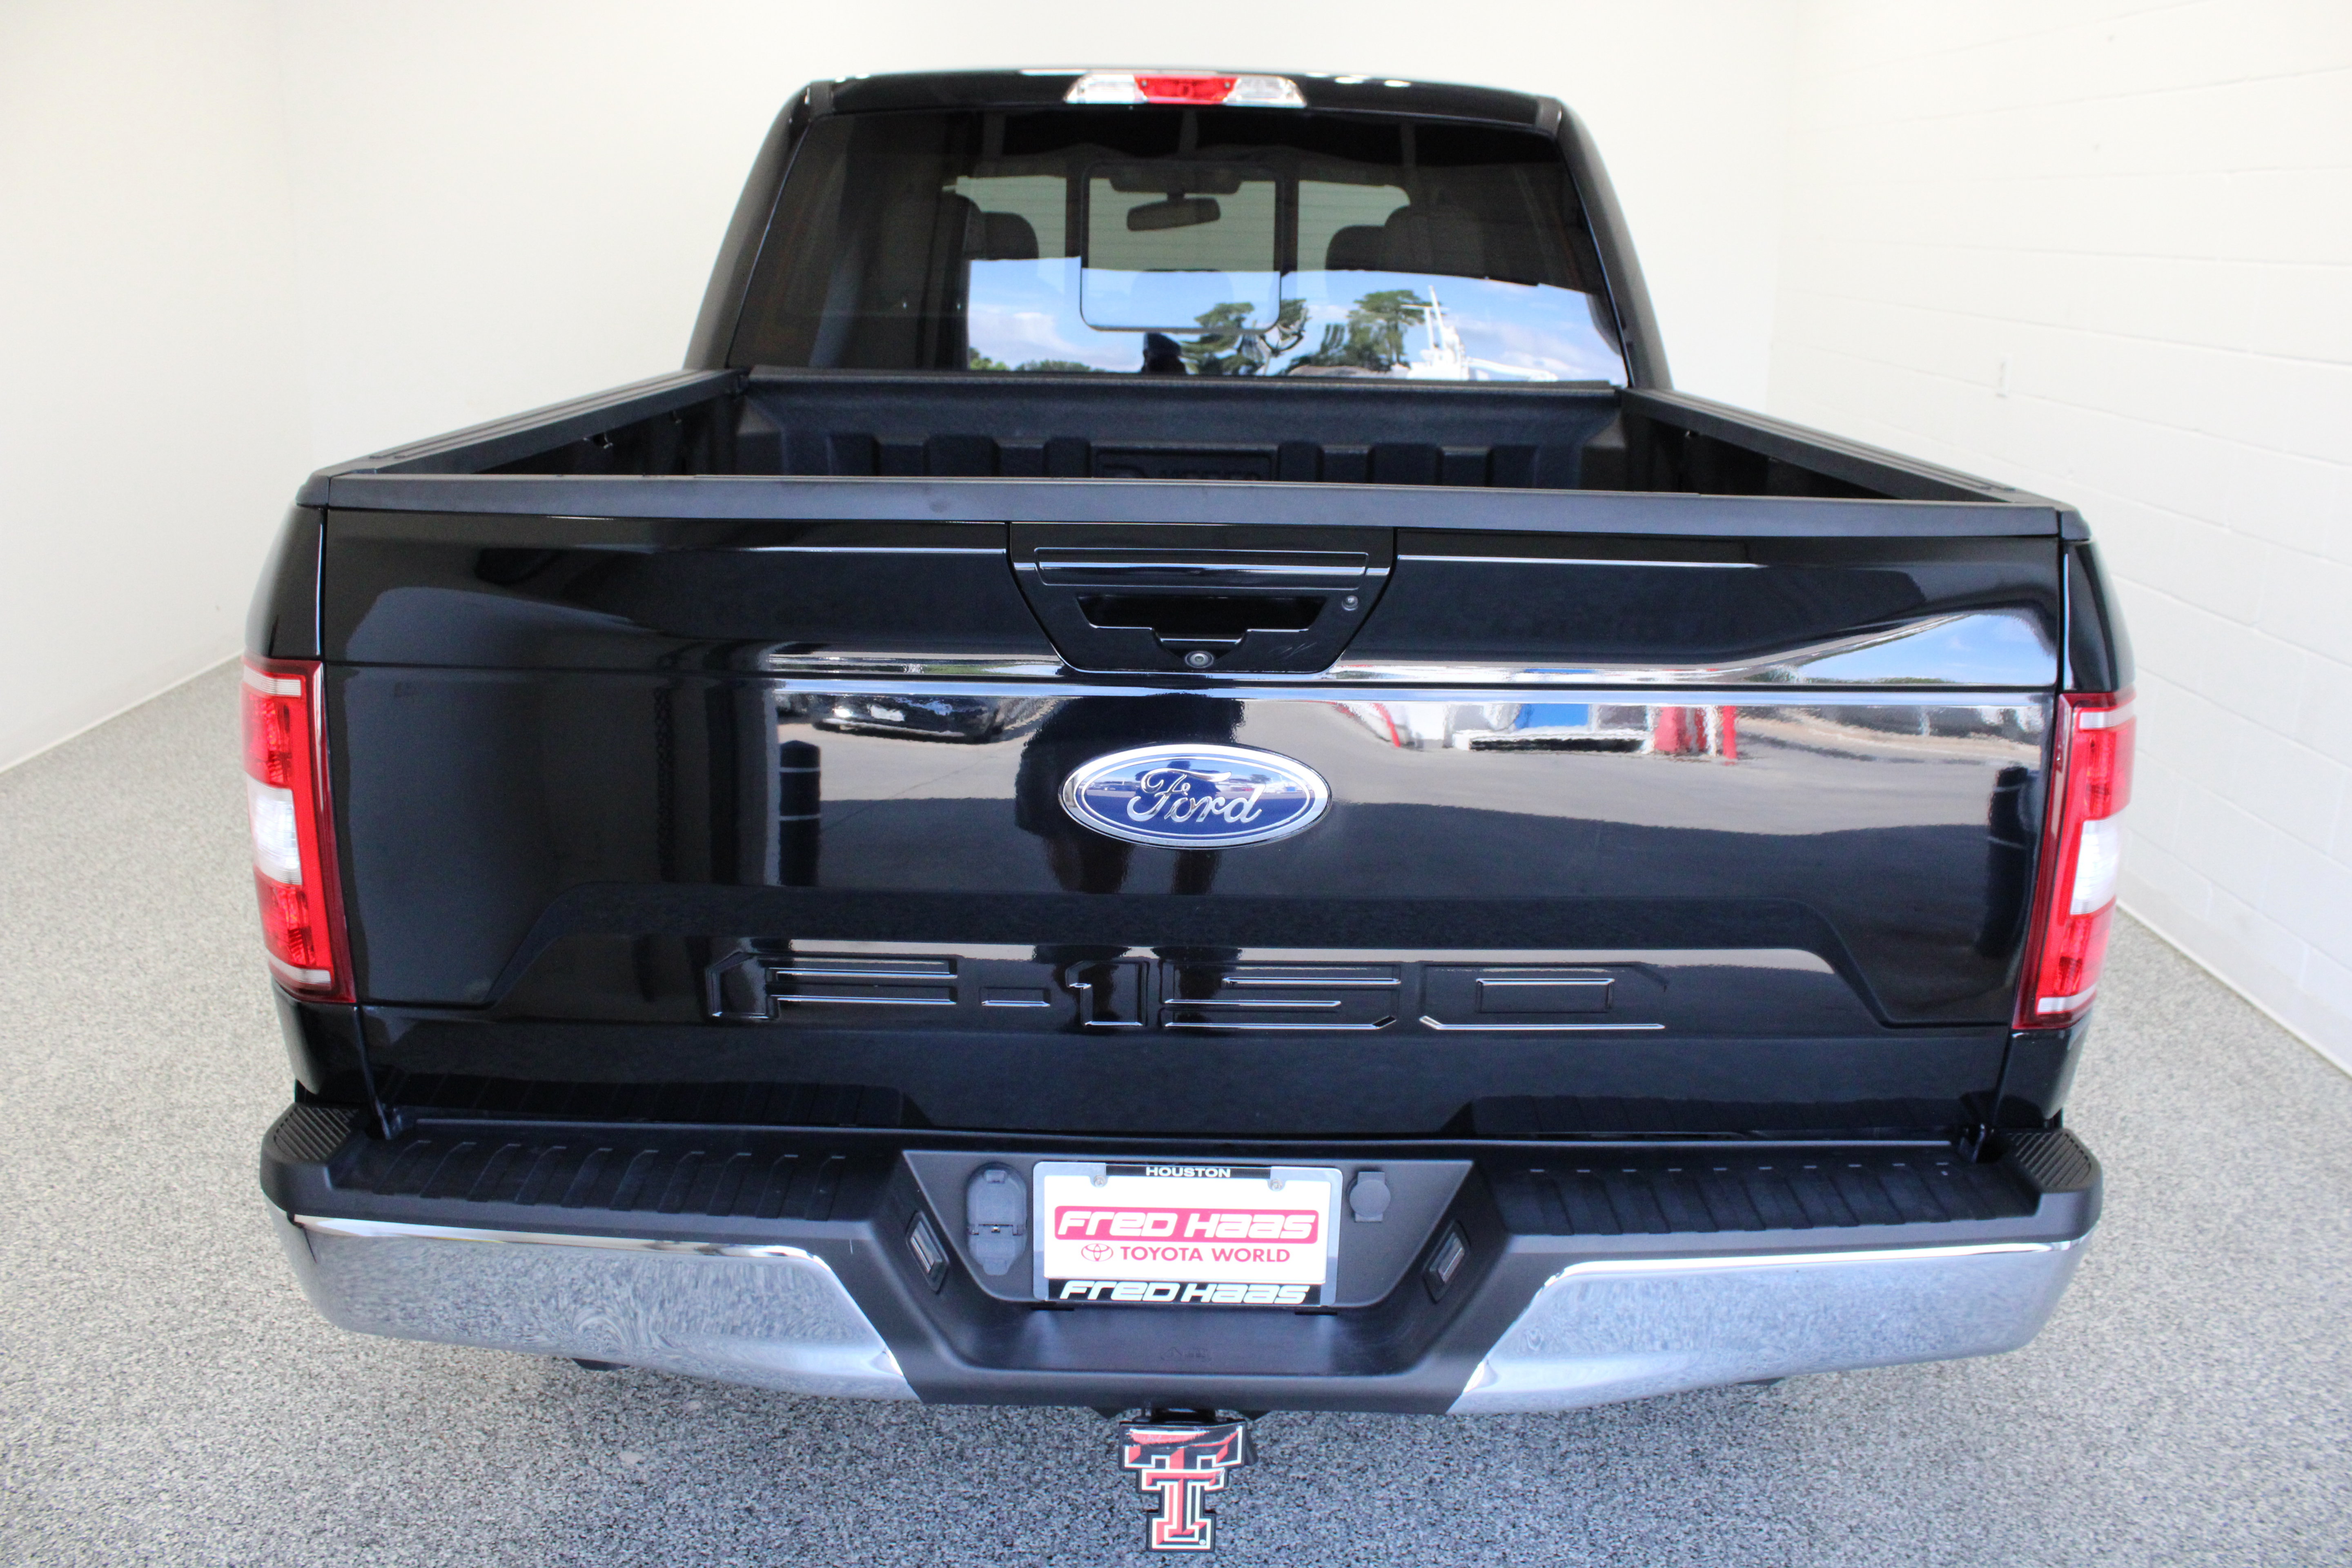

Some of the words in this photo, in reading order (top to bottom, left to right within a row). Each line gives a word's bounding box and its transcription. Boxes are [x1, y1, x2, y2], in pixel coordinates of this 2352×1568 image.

[1127, 768, 1265, 823] Ford
[706, 951, 1668, 1031] F-150
[1145, 1166, 1231, 1178] HOUSTON
[1120, 1246, 1203, 1262] TOYOTA
[1211, 1247, 1291, 1263] WORLD
